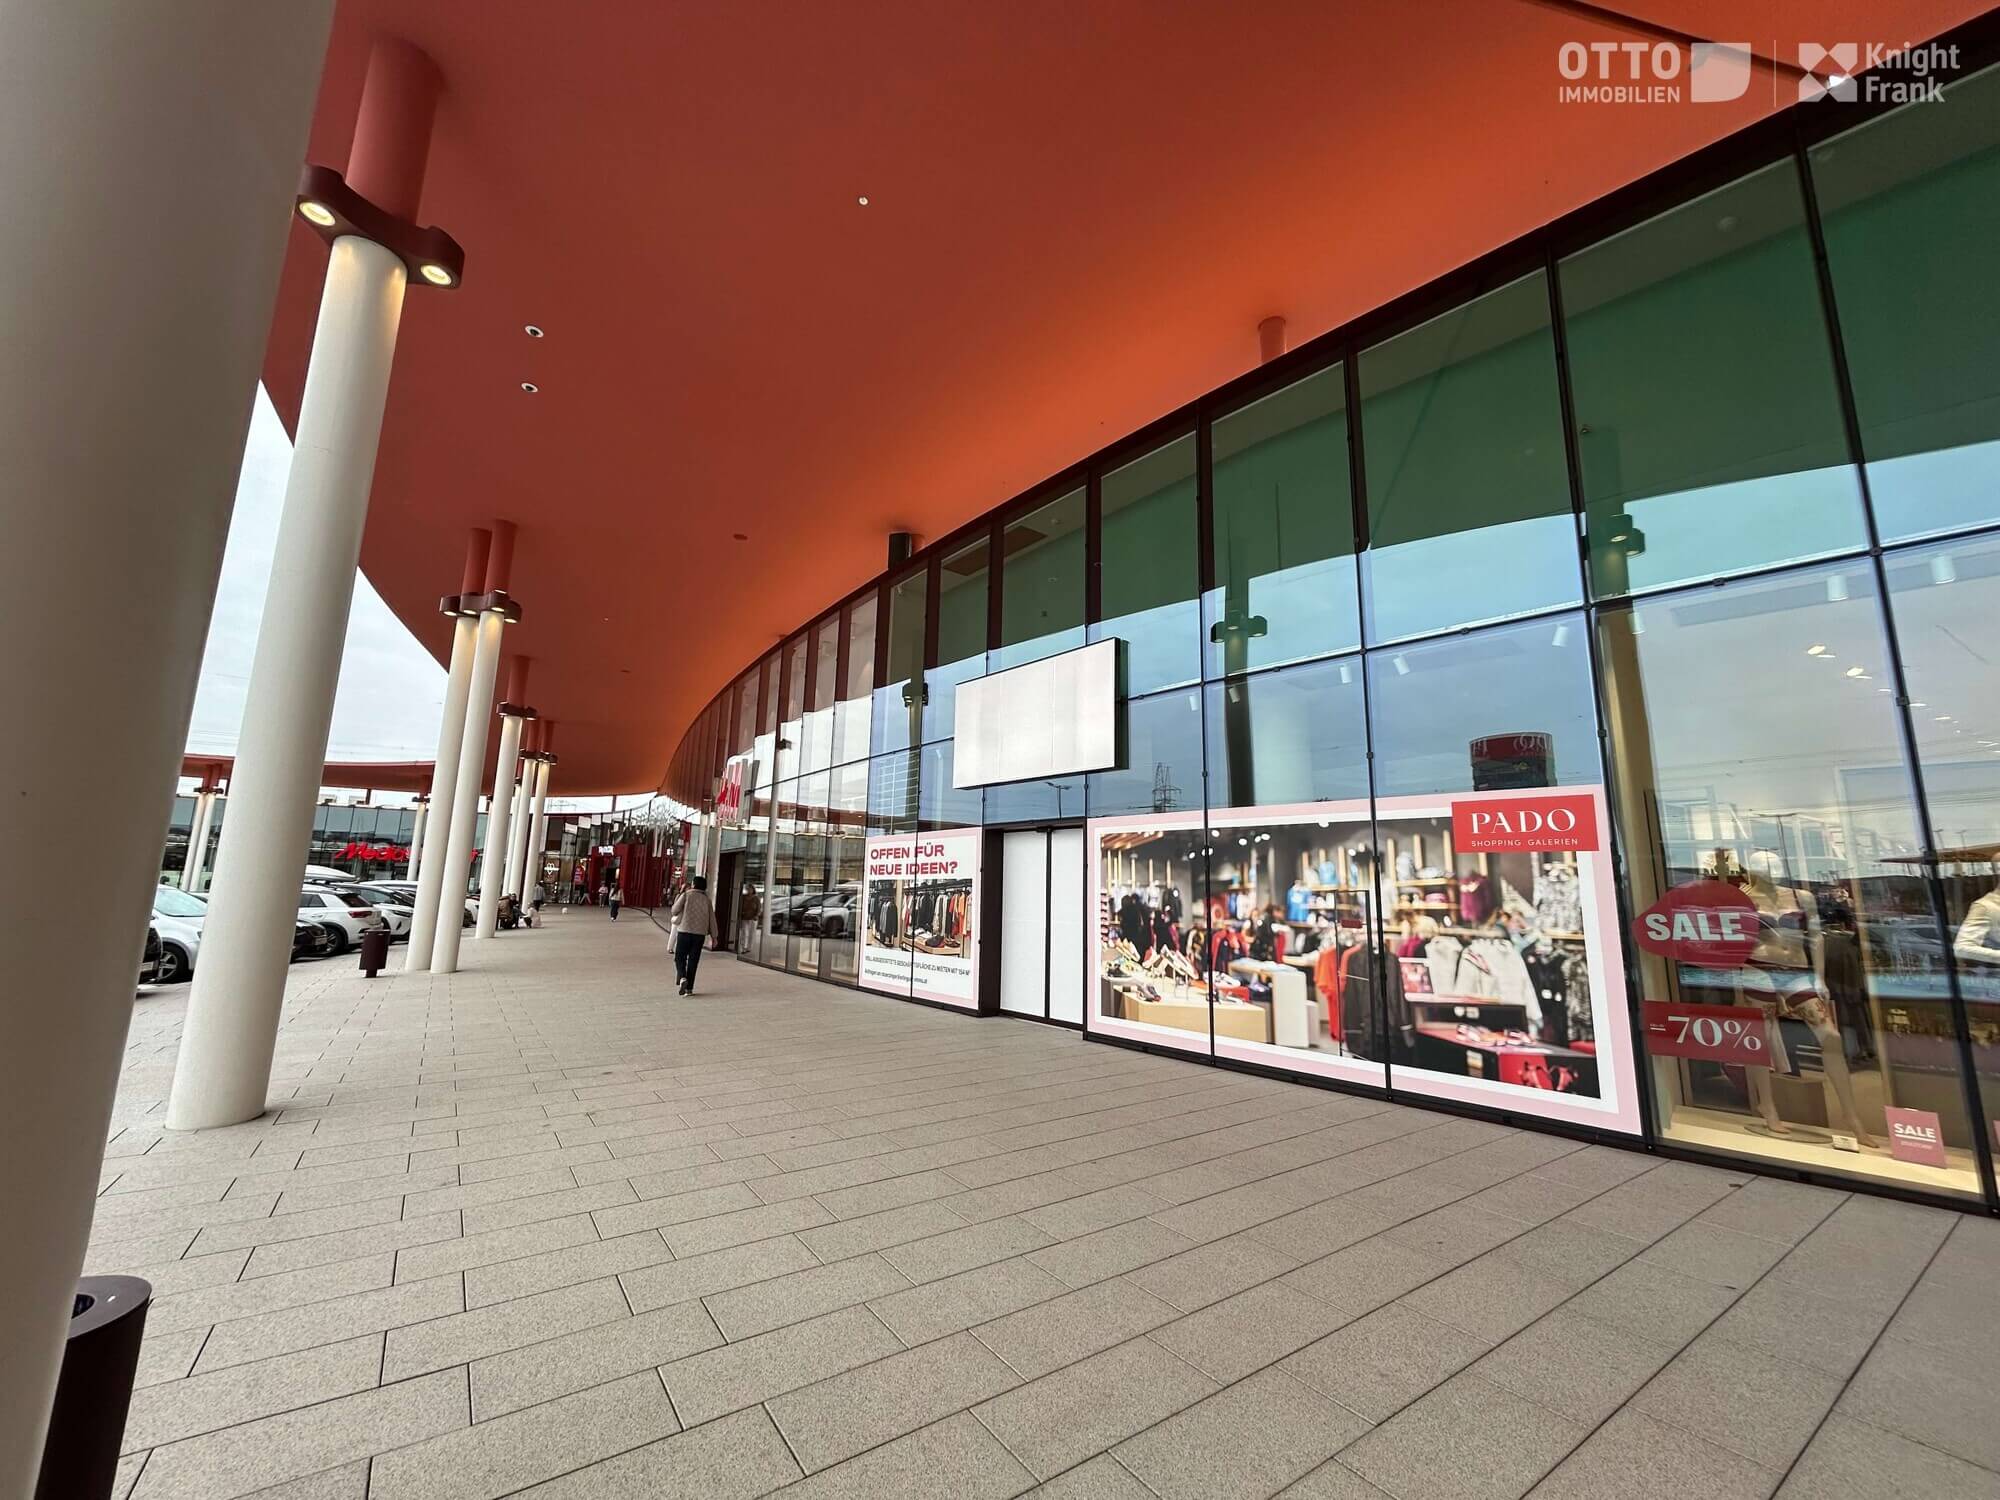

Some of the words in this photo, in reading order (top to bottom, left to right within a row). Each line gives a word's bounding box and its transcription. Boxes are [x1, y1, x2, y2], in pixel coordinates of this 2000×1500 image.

[1471, 808, 1576, 834] PADO
[870, 847, 910, 860] OFFEN
[914, 842, 945, 858] FÜR
[1471, 839, 1521, 847] SHOPPING
[1528, 838, 1578, 846] GALERIEN
[870, 863, 902, 876] NEUE
[906, 861, 958, 875] IDEEN?
[1645, 911, 1746, 941] SALE
[1893, 1122, 1936, 1139] SALE
